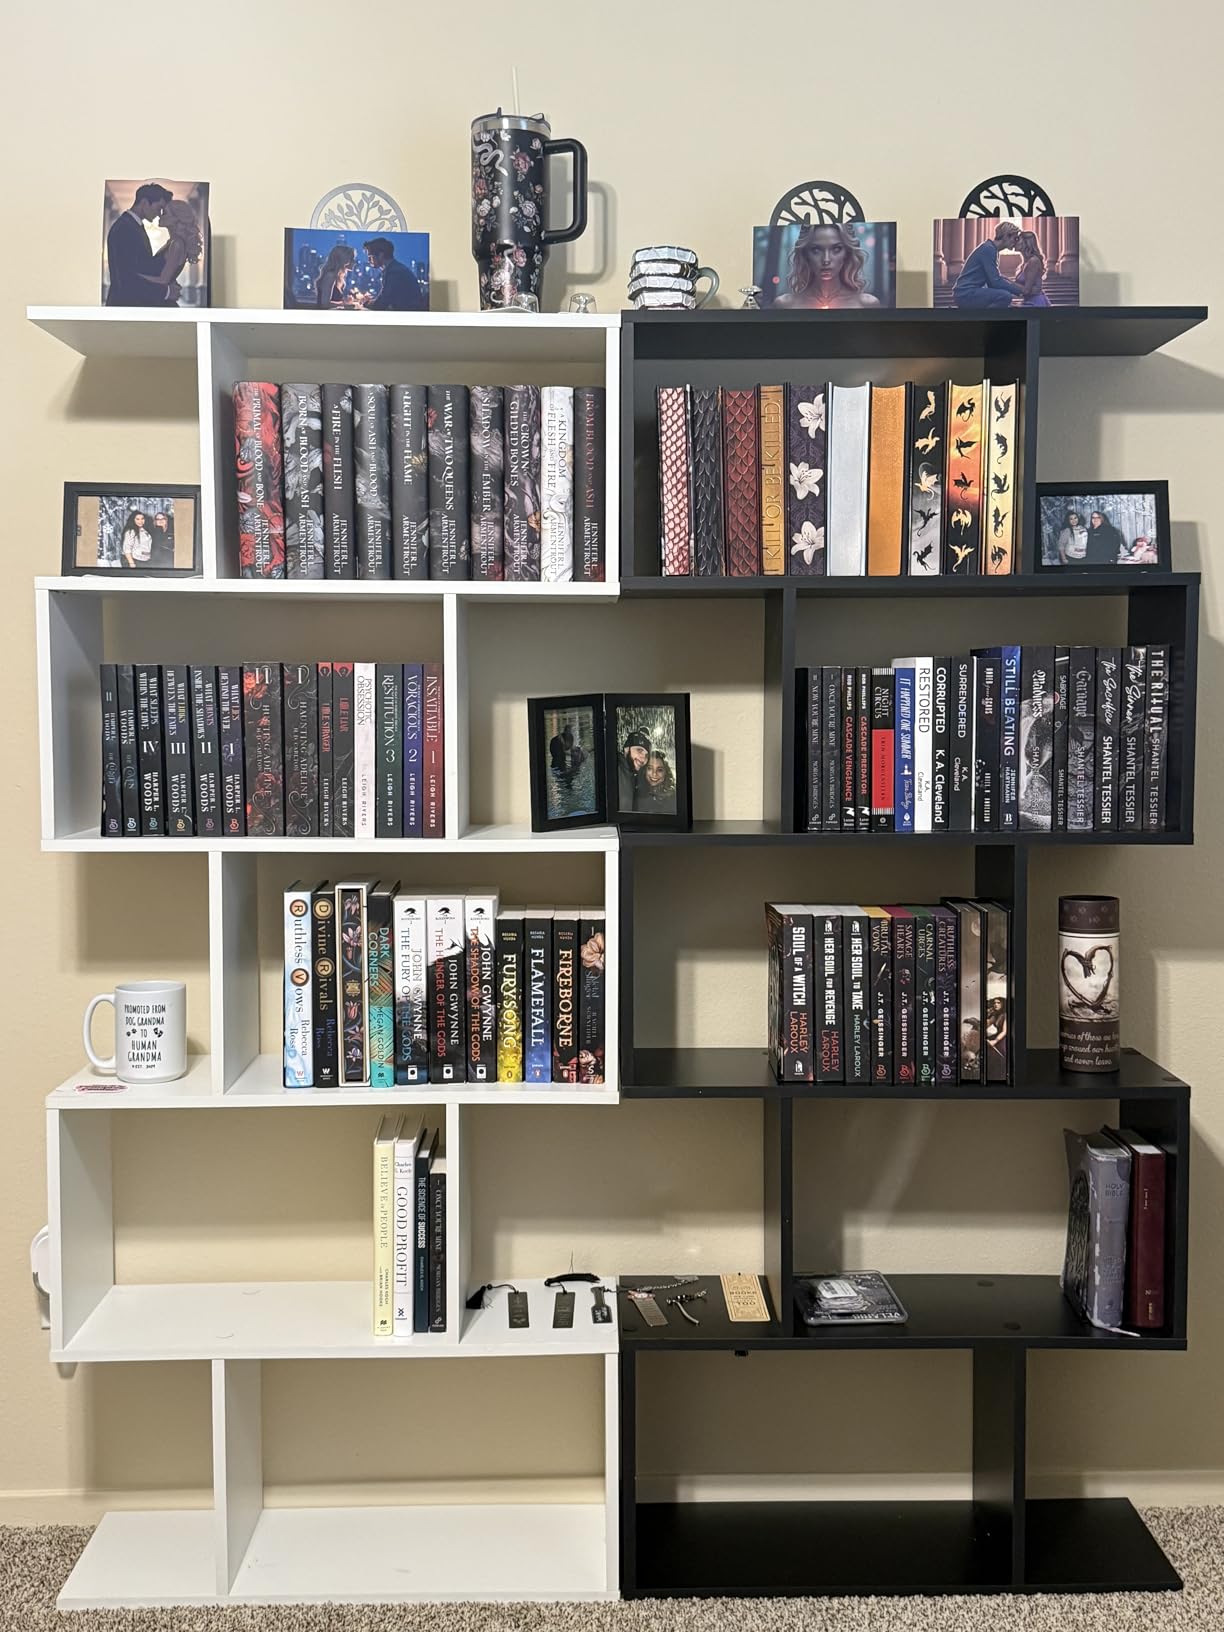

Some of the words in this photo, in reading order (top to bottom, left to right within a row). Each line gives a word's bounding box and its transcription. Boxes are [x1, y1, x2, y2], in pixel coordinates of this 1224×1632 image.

[332, 411, 341, 436] FIRE
[510, 401, 519, 446] GILDED
[586, 394, 594, 426] FROM
[520, 423, 531, 471] CROWN
[547, 413, 556, 447] FLESH
[299, 437, 308, 472] BLOOD
[403, 450, 412, 485] FLAME
[444, 438, 454, 466] TWO
[510, 449, 518, 486] BONES
[333, 458, 342, 490] FLESH
[369, 465, 378, 496] BLOOD
[481, 473, 492, 511] EMBER
[547, 463, 556, 488] FIRE
[766, 466, 781, 486] BE
[766, 494, 781, 519] OR
[332, 514, 341, 574] ARMENTROUT
[367, 514, 375, 574] ARMENTROUT
[442, 513, 450, 574] ARMENTROUT
[480, 516, 488, 575] ARMENTROUT
[583, 517, 591, 576] ARMENTROUT
[766, 525, 781, 560] KILL
[900, 678, 911, 686] IT
[1005, 659, 1016, 694] STILL
[1151, 651, 1164, 676] THE
[357, 676, 365, 725] OBSESSION
[382, 675, 394, 746] RESTITUTION
[406, 675, 417, 740] VORACIOUS
[427, 676, 438, 742] INSATIABLE
[874, 687, 882, 719] CIRCUS
[881, 688, 889, 717] NIGHT
[900, 688, 911, 718] HAPPENED
[919, 668, 930, 733] RESTORED
[936, 667, 946, 733] CORRUPTED
[958, 664, 967, 738] SURRENDERED
[1032, 669, 1047, 718] Madness
[1102, 678, 1117, 725] Sacrifice
[1126, 685, 1141, 724] Sinner
[901, 719, 912, 730] ONE
[1004, 699, 1015, 756] BEATING
[143, 741, 158, 753] IV
[409, 749, 417, 762] 2
[901, 733, 912, 760] SUMMER
[1102, 736, 1112, 782] SHANTEL
[1126, 737, 1136, 782] SHANTEL
[1150, 738, 1160, 782] SHANTEL
[1077, 747, 1085, 785] SHANTEL
[144, 773, 152, 812] WOODS
[171, 774, 180, 813] WOODS
[200, 774, 209, 812] WOODS
[225, 775, 234, 813] WOODS
[935, 776, 945, 823] Cleveland
[1102, 786, 1112, 823] TESSIER
[1126, 786, 1135, 823] TESSIER
[1150, 786, 1158, 824] TESSIER
[290, 899, 308, 964] Ruthless
[313, 898, 332, 955] Divine
[380, 927, 389, 957] DARK
[401, 928, 410, 950] THE
[792, 927, 805, 954] SOUL
[905, 924, 913, 958] SAVAGE
[368, 932, 378, 986] CORNERS
[481, 946, 490, 980] JOHN
[824, 938, 834, 953] HER
[852, 938, 862, 956] HER
[947, 925, 955, 968] RUTHLESS
[315, 957, 334, 1010] Rivals
[401, 954, 410, 982] FURY
[411, 949, 422, 982] JOHN
[436, 950, 444, 991] HUNGER
[448, 959, 457, 989] JOHN
[825, 954, 835, 977] SOUL
[852, 957, 862, 980] SOUL
[125, 1004, 150, 1014] PROMOTED
[152, 1004, 166, 1013] FROM
[290, 968, 309, 1013] Vows
[437, 995, 445, 1007] OF
[501, 954, 516, 1049] FURYSONG
[531, 948, 545, 1047] FLAMEFALL
[557, 949, 572, 1047] FIREBORNE
[793, 975, 806, 1006] WITCH
[825, 990, 836, 1025] REVENGE
[852, 991, 863, 1010] TAKE
[126, 1017, 136, 1026] DOG
[137, 1017, 164, 1026] GRANDMA
[413, 986, 423, 1040] GWYNNE
[437, 1009, 445, 1028] THE
[450, 994, 459, 1045] GWYNNE
[471, 1012, 480, 1032] THE
[482, 984, 492, 1041] GWYNNE
[132, 1040, 157, 1050] HUMAN
[141, 1029, 147, 1037] TO
[290, 1028, 298, 1049] Ross
[302, 1019, 310, 1056] Rebecca
[437, 1030, 445, 1057] GODS
[472, 1034, 480, 1062] GODS
[790, 1012, 798, 1053] LAROUX
[799, 1013, 808, 1053] HARLEY
[822, 1030, 830, 1072] LAROUX
[128, 1051, 162, 1061] GRANDMA
[377, 1037, 385, 1068] GOLDIN
[831, 1031, 839, 1072] HARLEY
[396, 1186, 408, 1230] GOOD
[418, 1189, 426, 1213] SCIENCE
[396, 1234, 408, 1284] PROFIT
